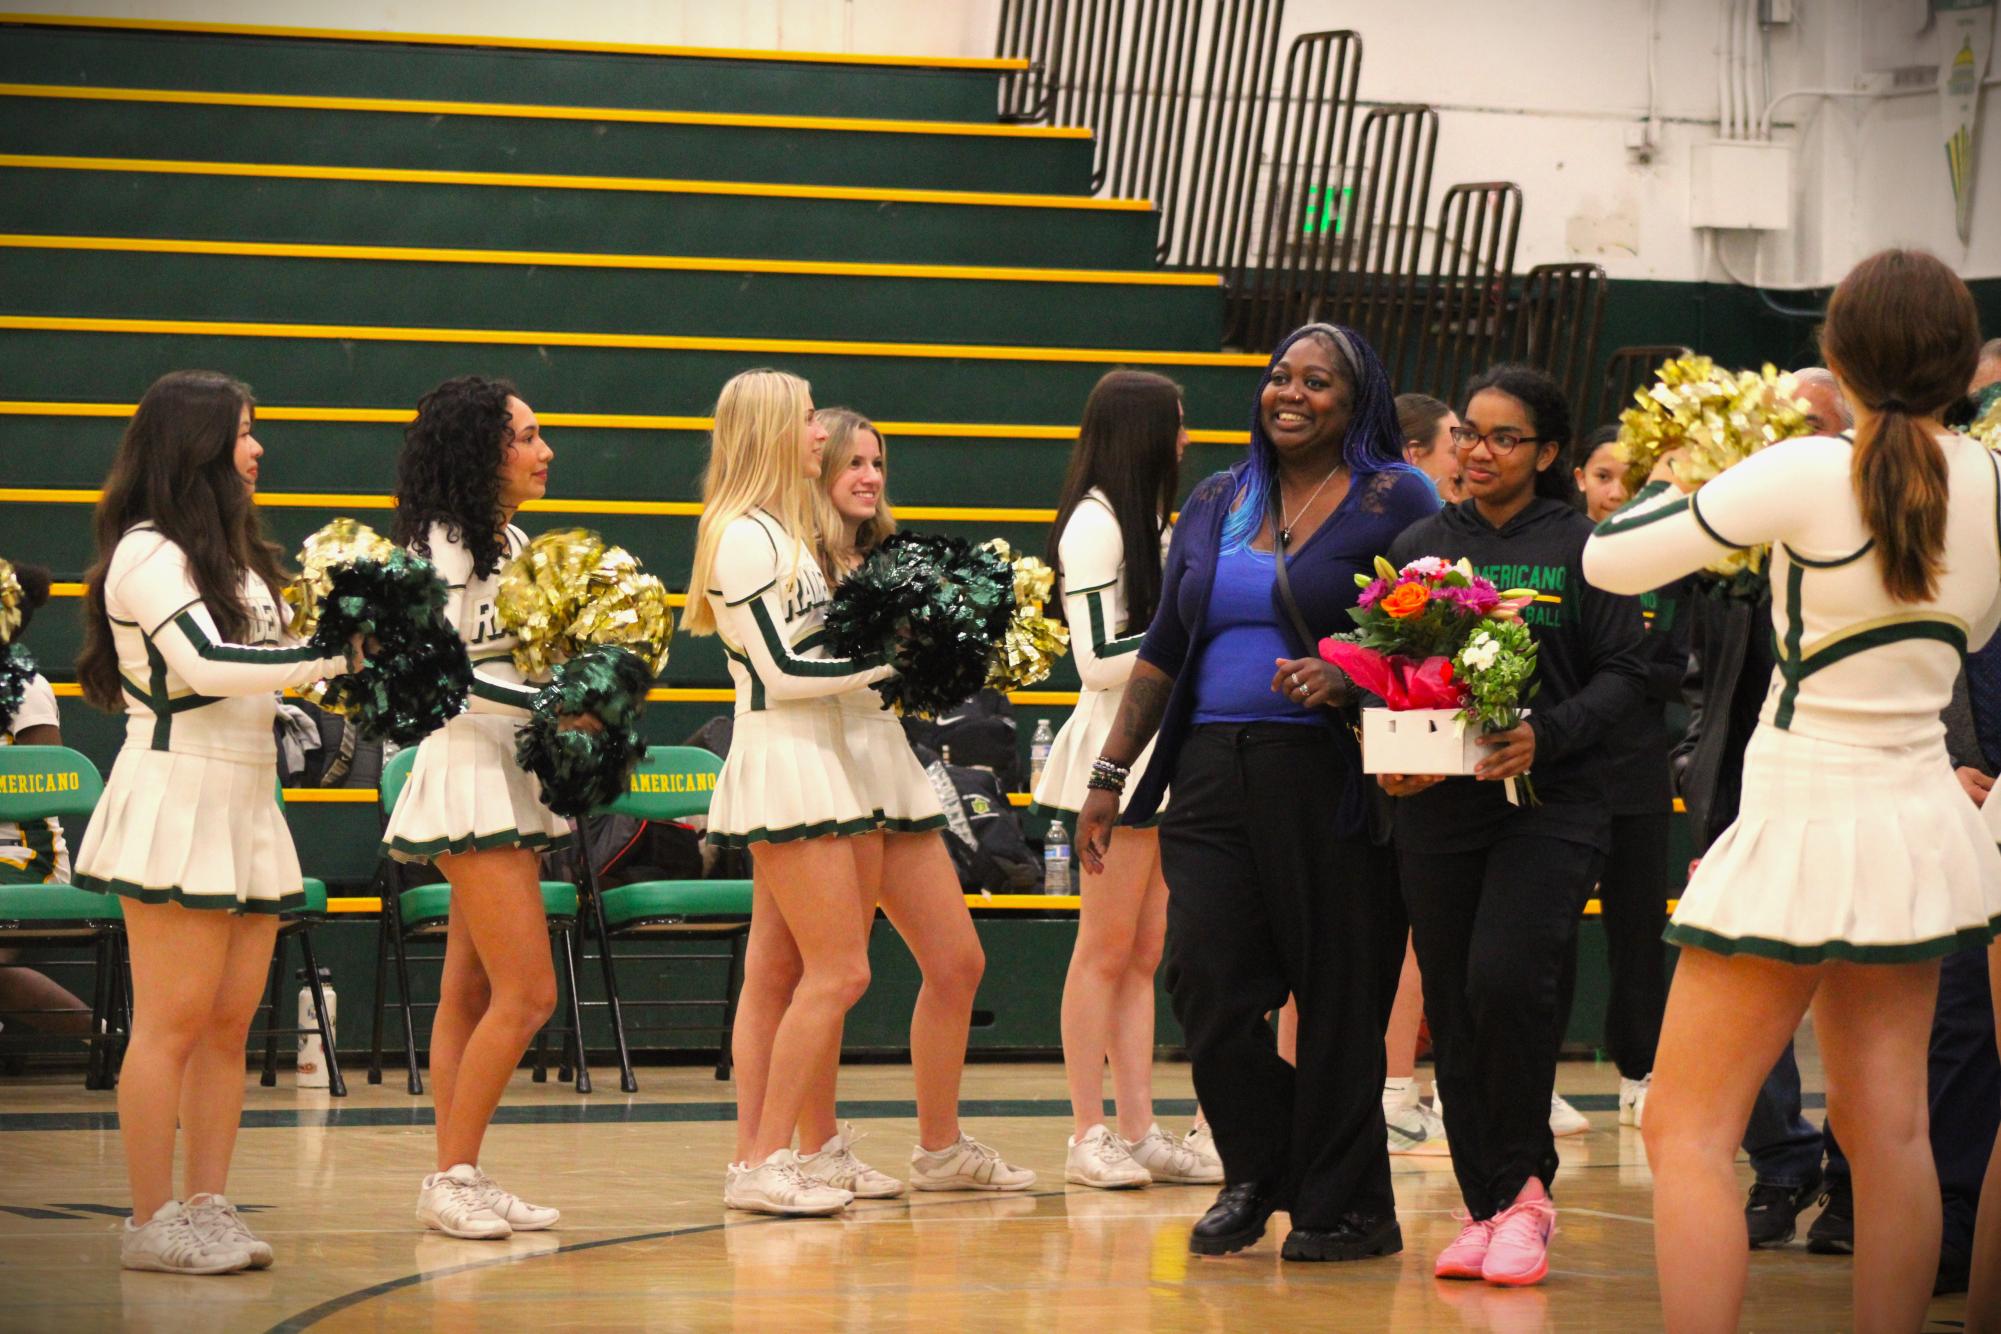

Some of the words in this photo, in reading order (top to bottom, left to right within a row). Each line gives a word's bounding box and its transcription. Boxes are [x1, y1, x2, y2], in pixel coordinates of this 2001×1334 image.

[1473, 564, 1566, 591] MERICANO
[1525, 605, 1561, 627] BALL
[0, 772, 79, 793] MERICANO
[630, 772, 717, 793] AMERICANO
